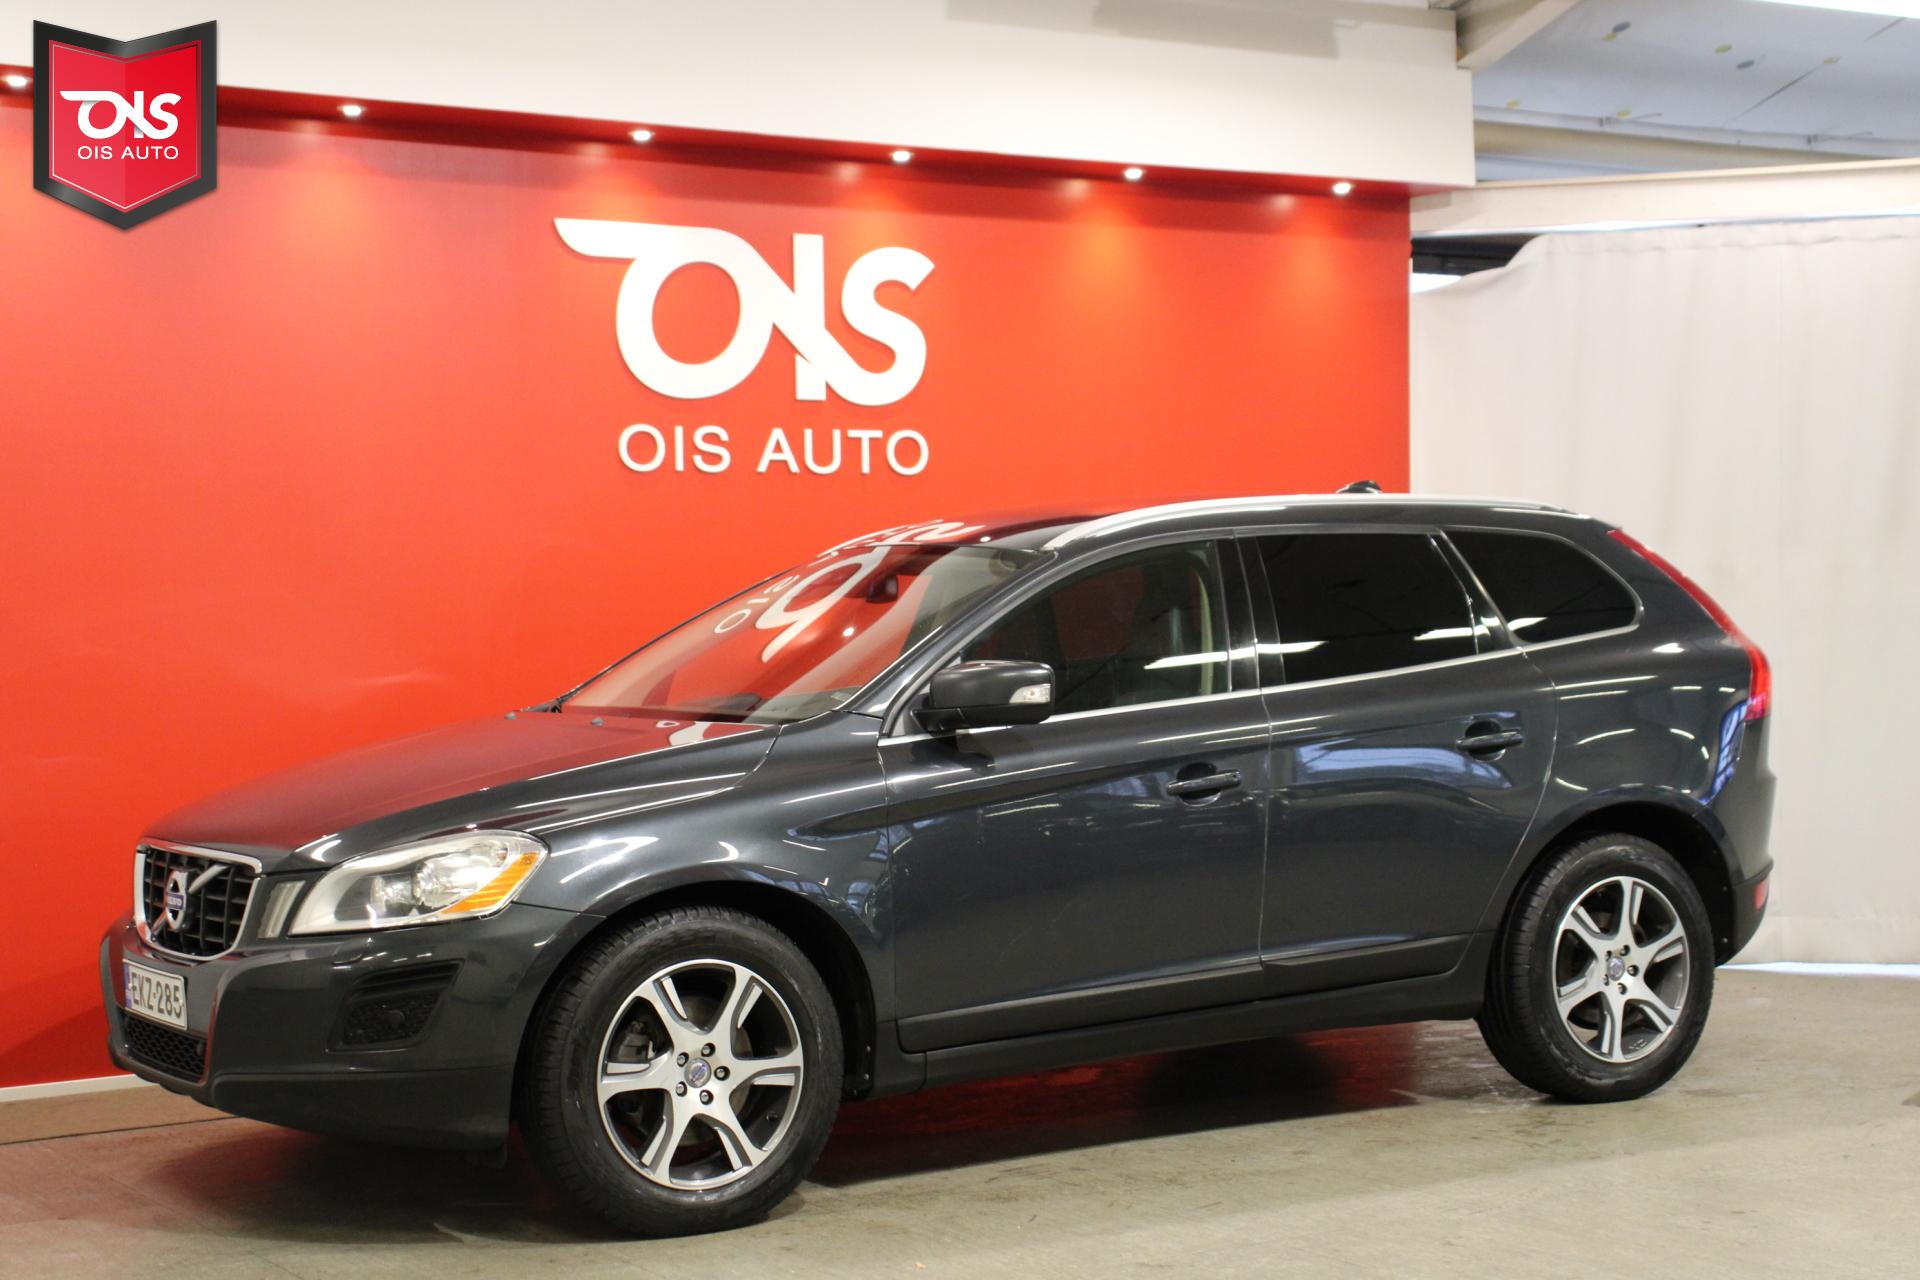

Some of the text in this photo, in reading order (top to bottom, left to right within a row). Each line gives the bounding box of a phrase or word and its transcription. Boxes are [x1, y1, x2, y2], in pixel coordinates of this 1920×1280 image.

[618, 423, 930, 475] OIS AUTO
[131, 972, 183, 1018] EKZ-285
